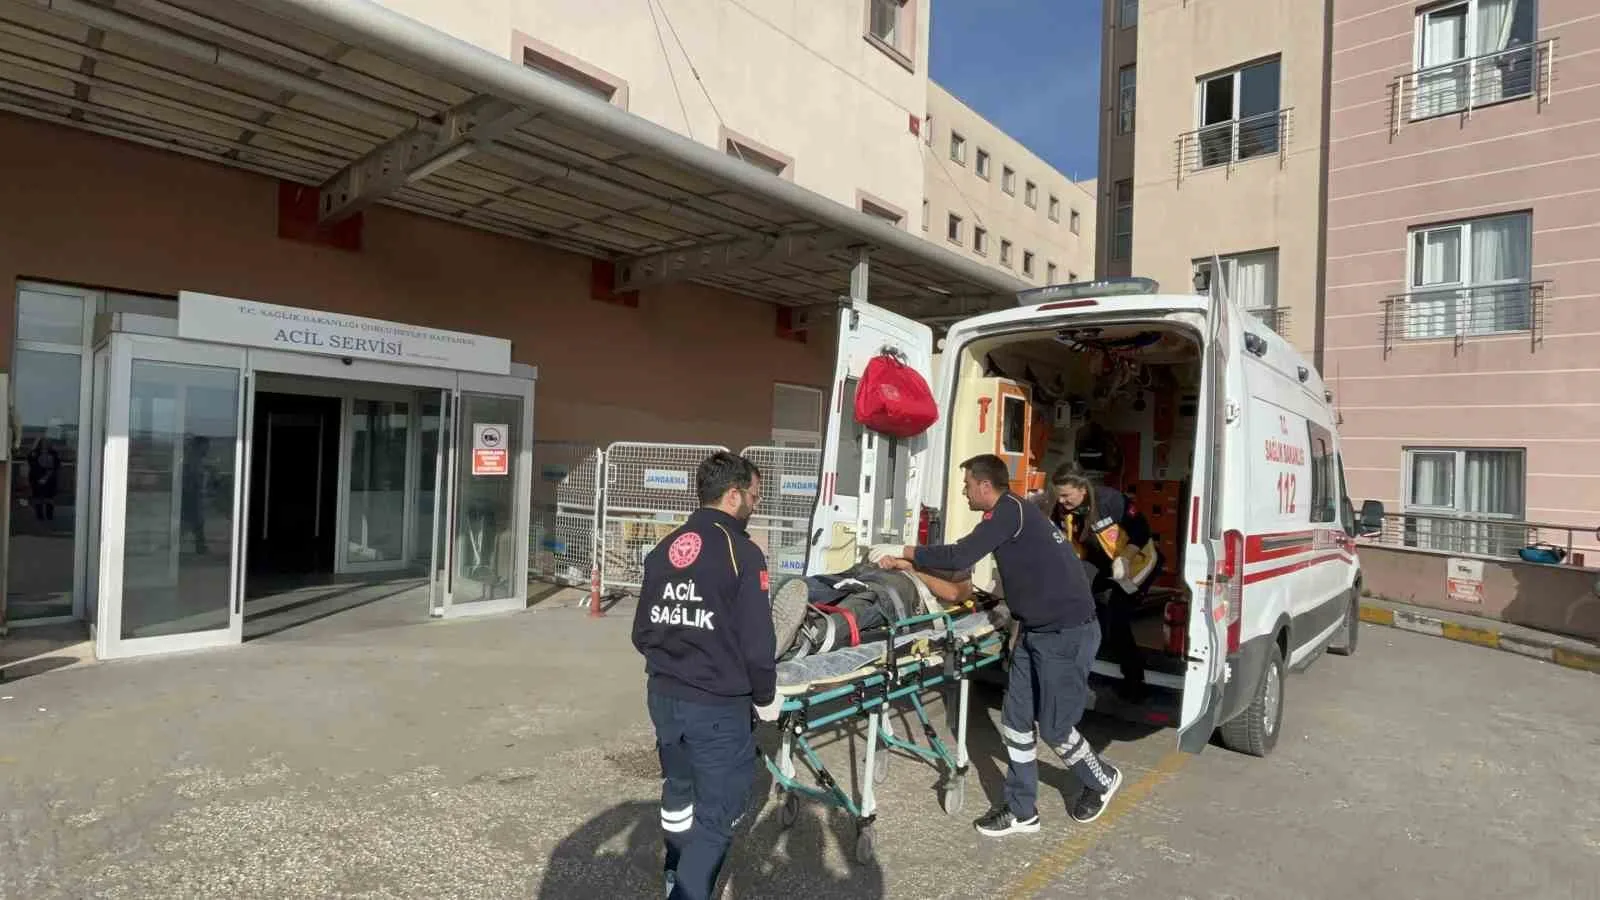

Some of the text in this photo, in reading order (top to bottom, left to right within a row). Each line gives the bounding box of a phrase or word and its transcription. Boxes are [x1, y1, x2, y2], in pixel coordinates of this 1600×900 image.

[274, 327, 402, 356] ACİL SERVİSİ
[647, 475, 688, 485] JANDARMA
[1277, 472, 1297, 513] 112
[663, 579, 703, 601] ACİL
[650, 604, 715, 630] SAĞLIK
